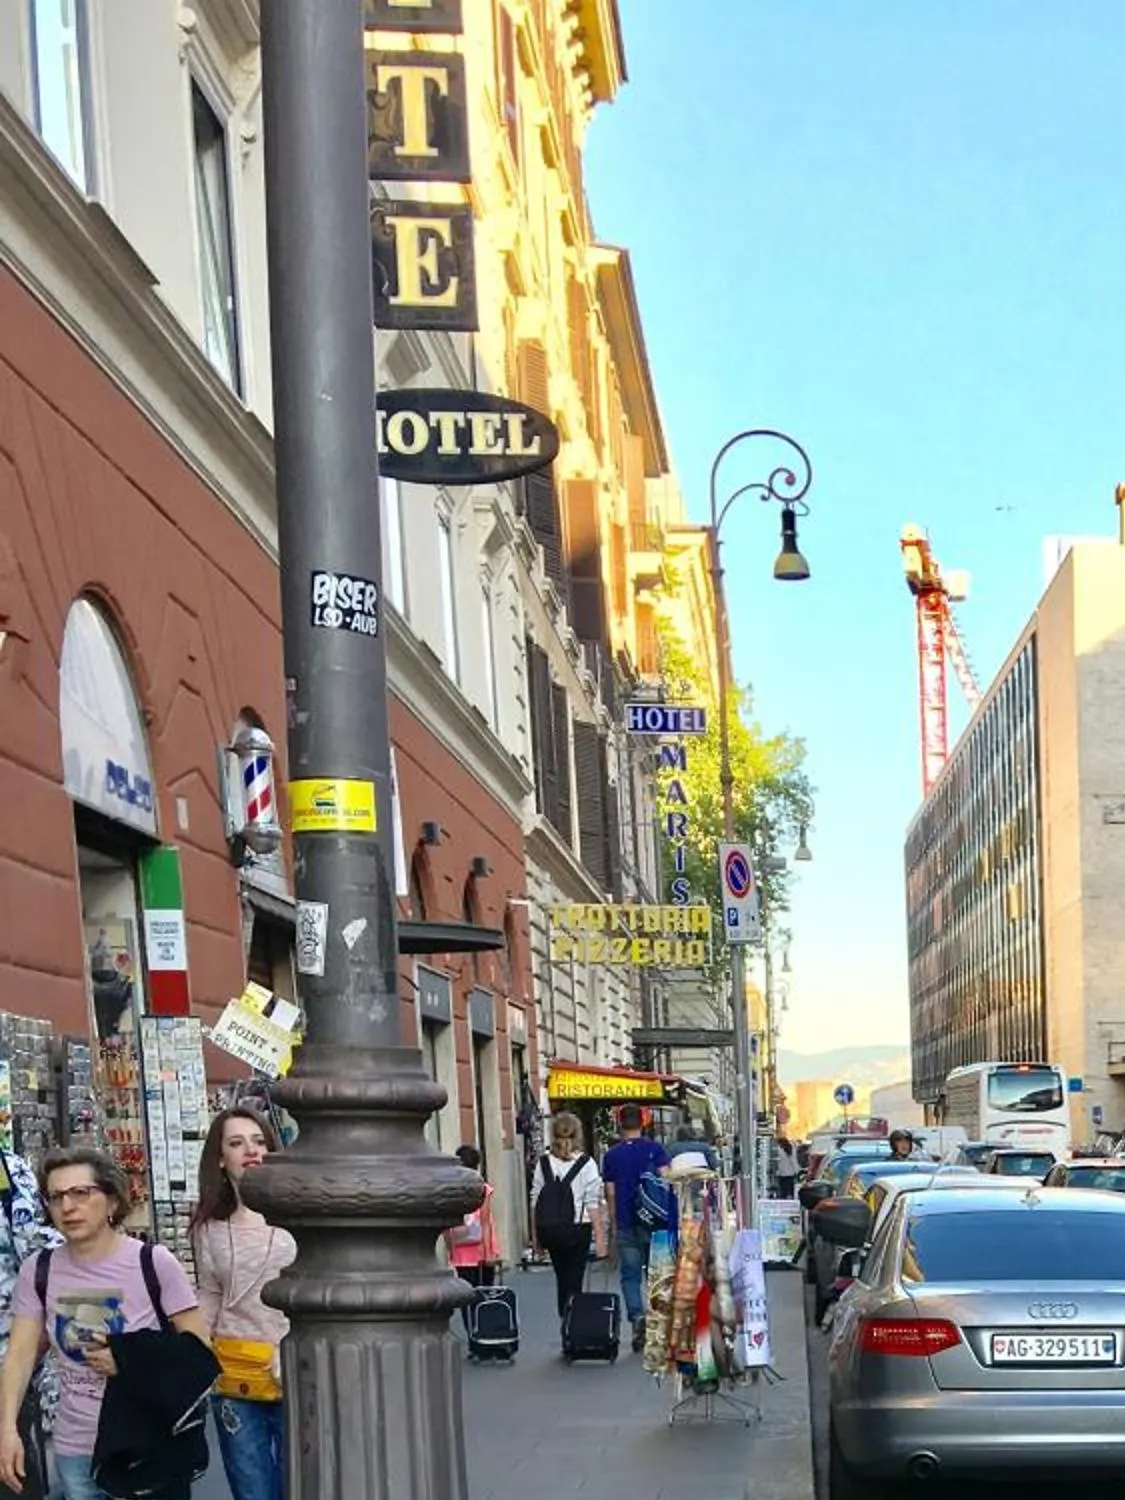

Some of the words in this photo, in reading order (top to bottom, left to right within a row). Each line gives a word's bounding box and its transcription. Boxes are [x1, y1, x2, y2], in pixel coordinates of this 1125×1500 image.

[313, 574, 377, 615] BISER
[627, 707, 706, 731] HOTEL
[659, 744, 691, 905] MARIS
[550, 905, 711, 933] TRATTORIA
[551, 937, 705, 965] PIZZERIA
[557, 1083, 658, 1098] RISTORANTE
